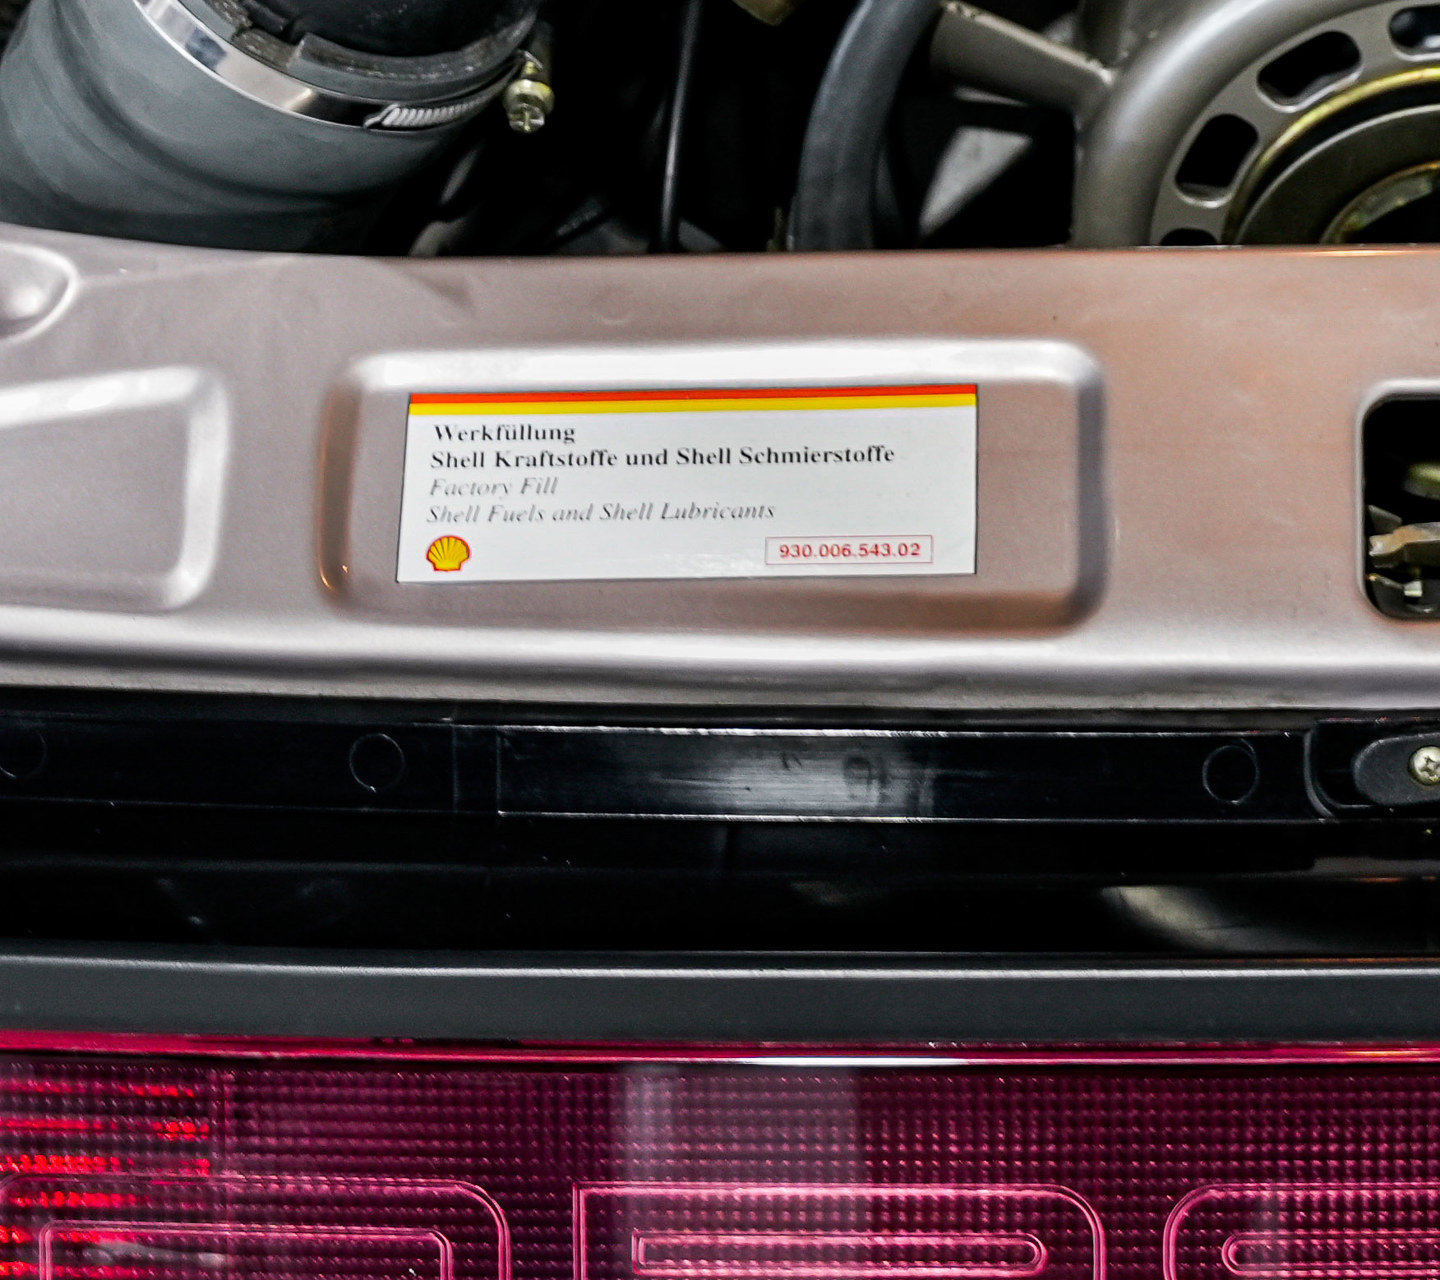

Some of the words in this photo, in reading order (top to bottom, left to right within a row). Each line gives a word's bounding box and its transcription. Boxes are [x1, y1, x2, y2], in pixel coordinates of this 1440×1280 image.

[434, 423, 576, 445] Werkfüllung
[430, 450, 485, 468] Shell
[494, 449, 618, 468] Kraftstoffe
[625, 447, 668, 466] und
[676, 447, 731, 465] Shell
[738, 444, 895, 465] Schmierstoffe
[429, 477, 513, 499] Factory
[520, 476, 559, 495] Fill
[427, 504, 481, 523] Shell
[487, 503, 544, 523] Fuels
[552, 502, 594, 522] and
[599, 501, 654, 521] Shell
[660, 501, 776, 521] Lubricants
[778, 542, 921, 558] 930.006.543.02
